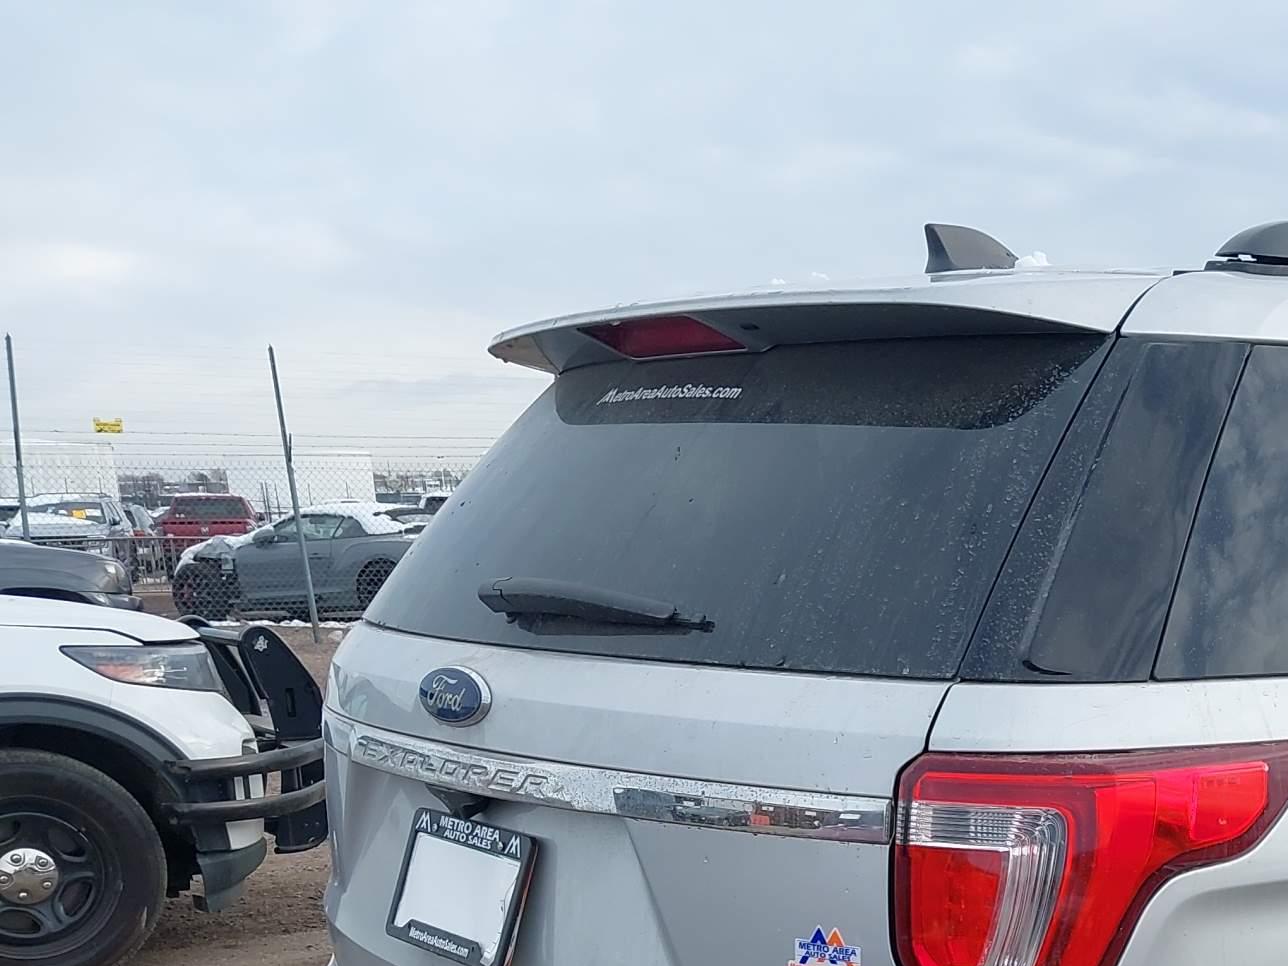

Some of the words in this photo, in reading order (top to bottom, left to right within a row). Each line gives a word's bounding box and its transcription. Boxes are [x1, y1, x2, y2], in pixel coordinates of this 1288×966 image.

[596, 383, 742, 406] MetroAreaAutoSales.com
[427, 674, 466, 712] Ford
[357, 735, 554, 800] EXPLORER
[439, 815, 472, 834] METRO
[473, 824, 500, 842] AREA
[443, 829, 466, 842] AUTO
[467, 836, 492, 850] SALES
[798, 941, 830, 953] METRO
[832, 946, 857, 957] AREA
[804, 950, 826, 959] AUTO
